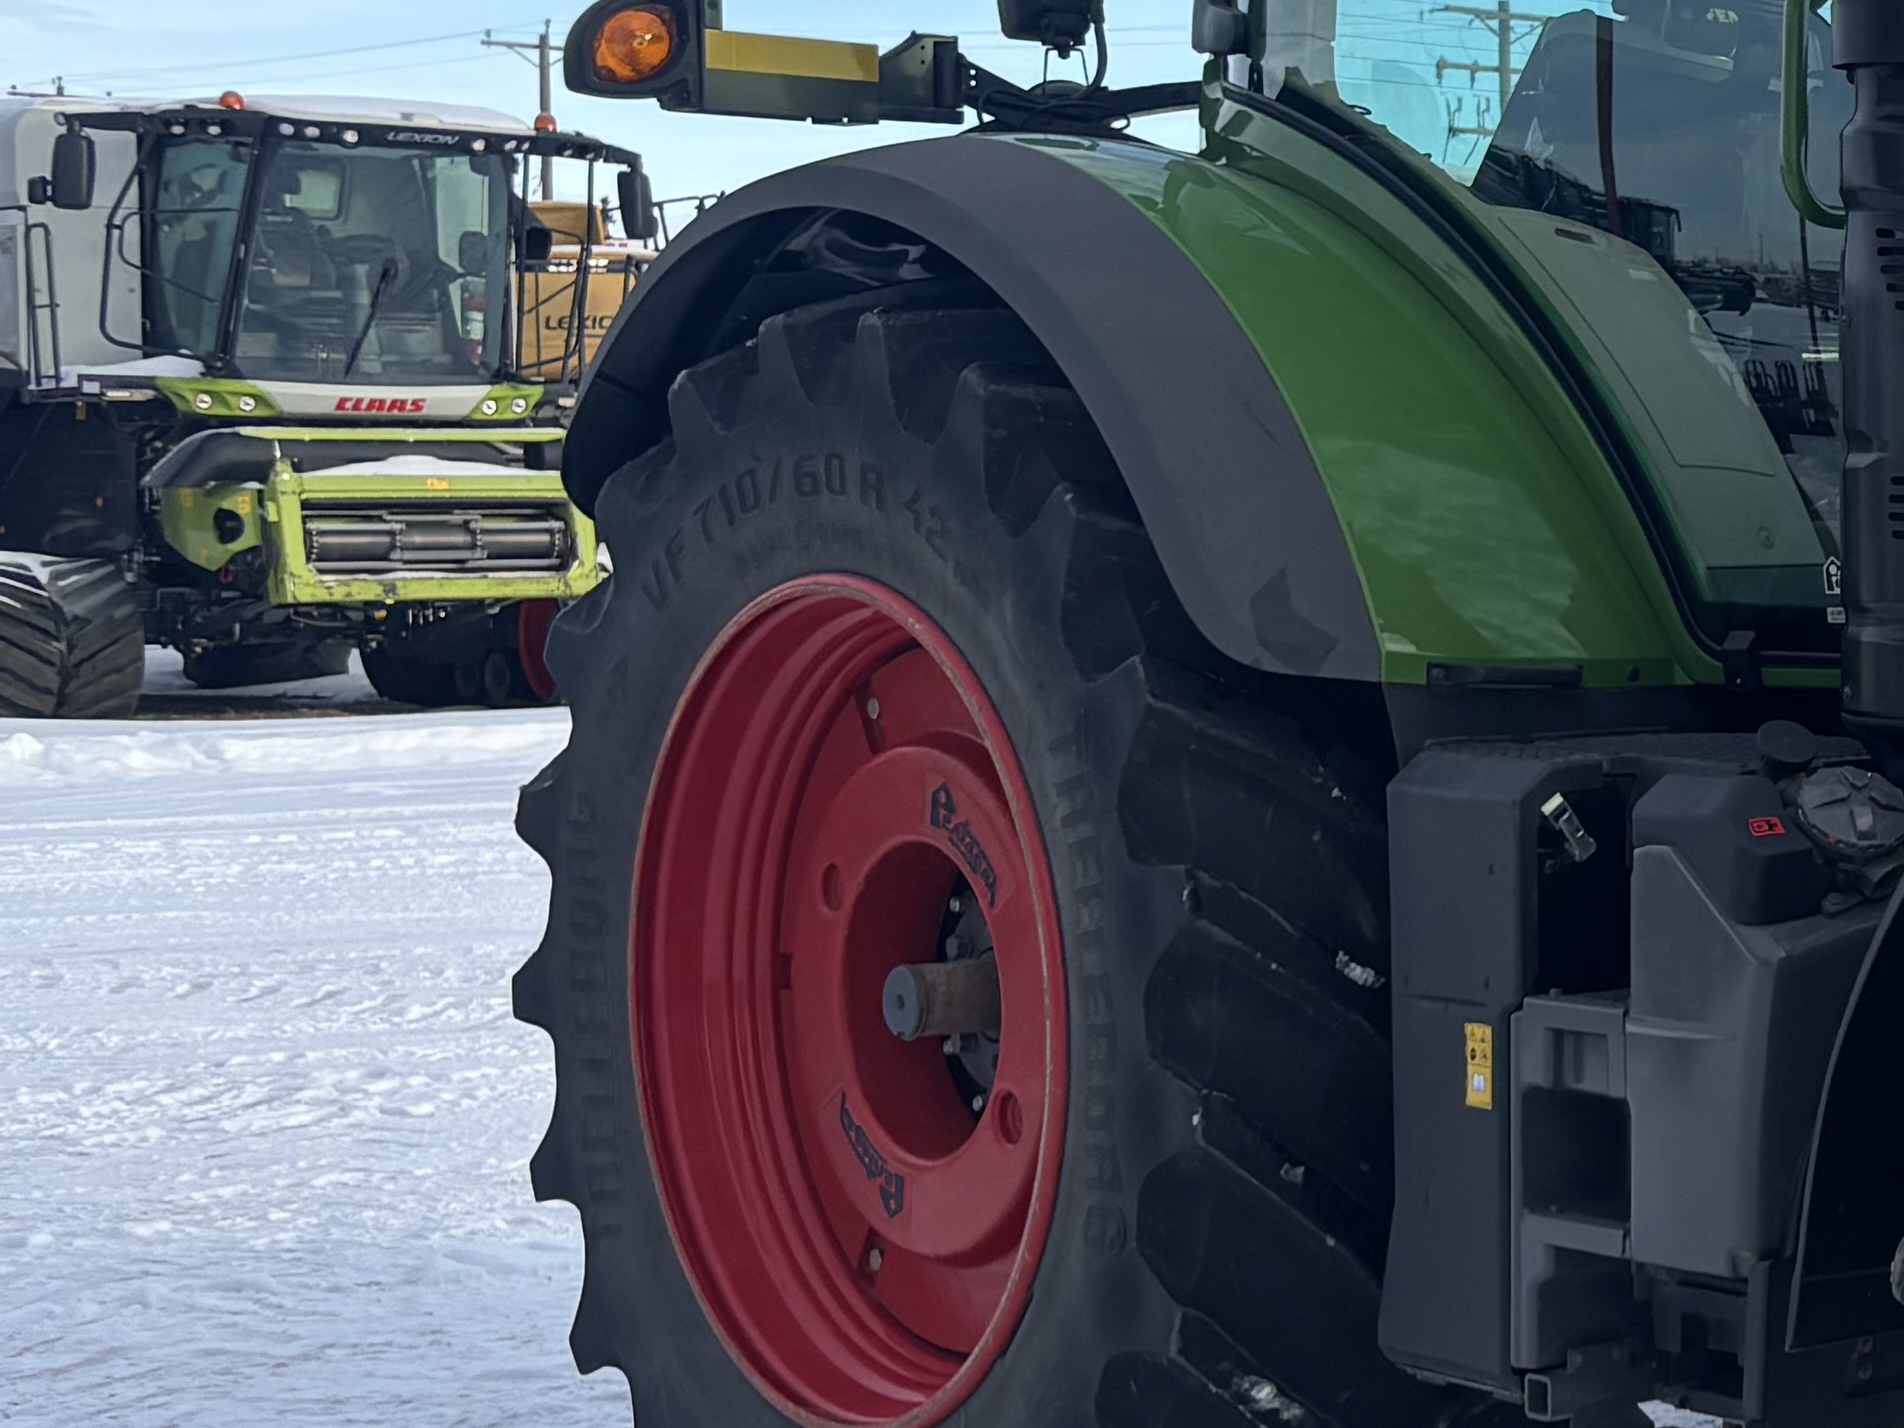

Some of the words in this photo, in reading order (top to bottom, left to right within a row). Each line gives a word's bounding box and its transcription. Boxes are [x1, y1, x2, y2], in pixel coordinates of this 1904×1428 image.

[387, 131, 460, 145] LEXION
[334, 396, 427, 413] CLAAS
[640, 527, 692, 614] VF
[692, 449, 849, 548] 710/60
[858, 460, 888, 514] R
